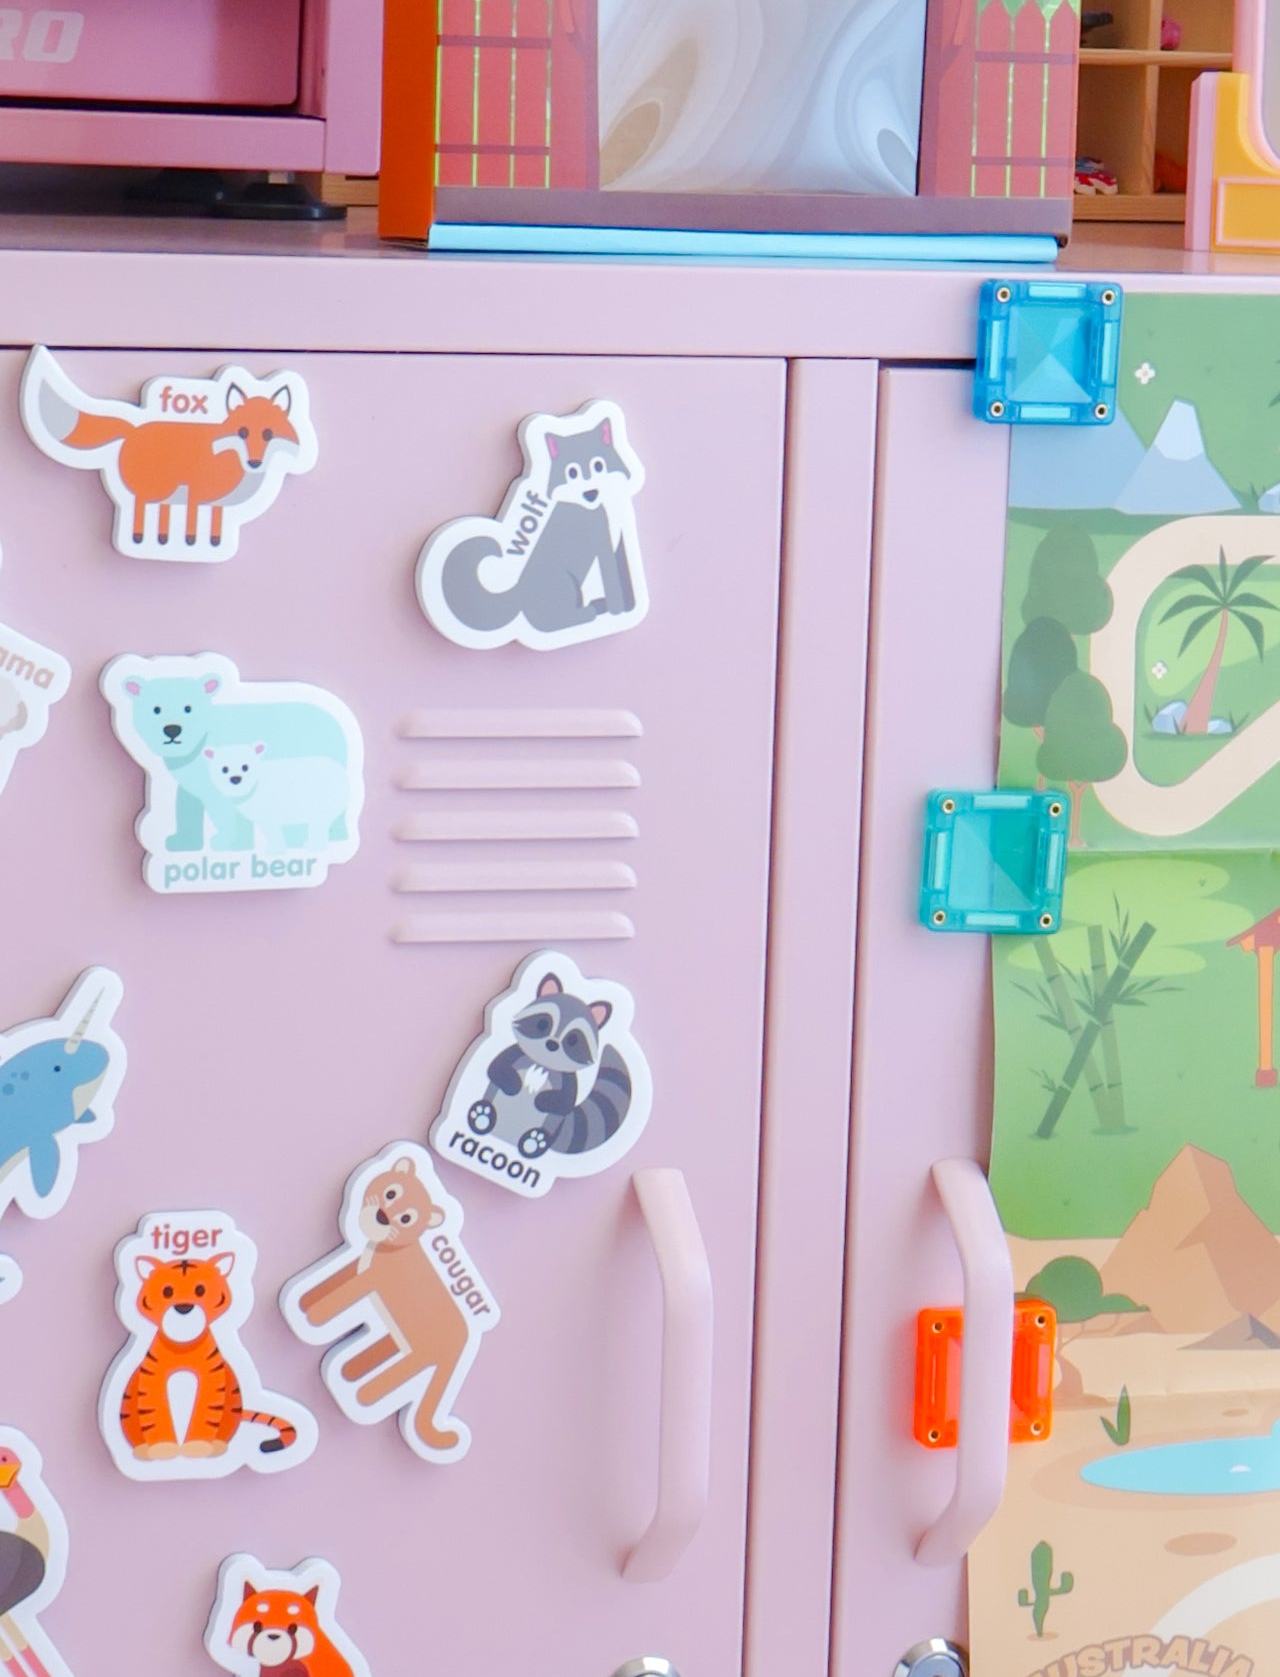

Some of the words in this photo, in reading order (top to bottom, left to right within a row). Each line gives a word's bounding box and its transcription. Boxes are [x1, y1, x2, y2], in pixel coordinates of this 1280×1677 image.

[159, 385, 208, 416] fox
[506, 489, 550, 558] wolf
[163, 854, 240, 889] polar
[250, 853, 317, 879] bear
[449, 1127, 542, 1189] racoon
[150, 1224, 223, 1257] tiger
[430, 1235, 492, 1320] cougar
